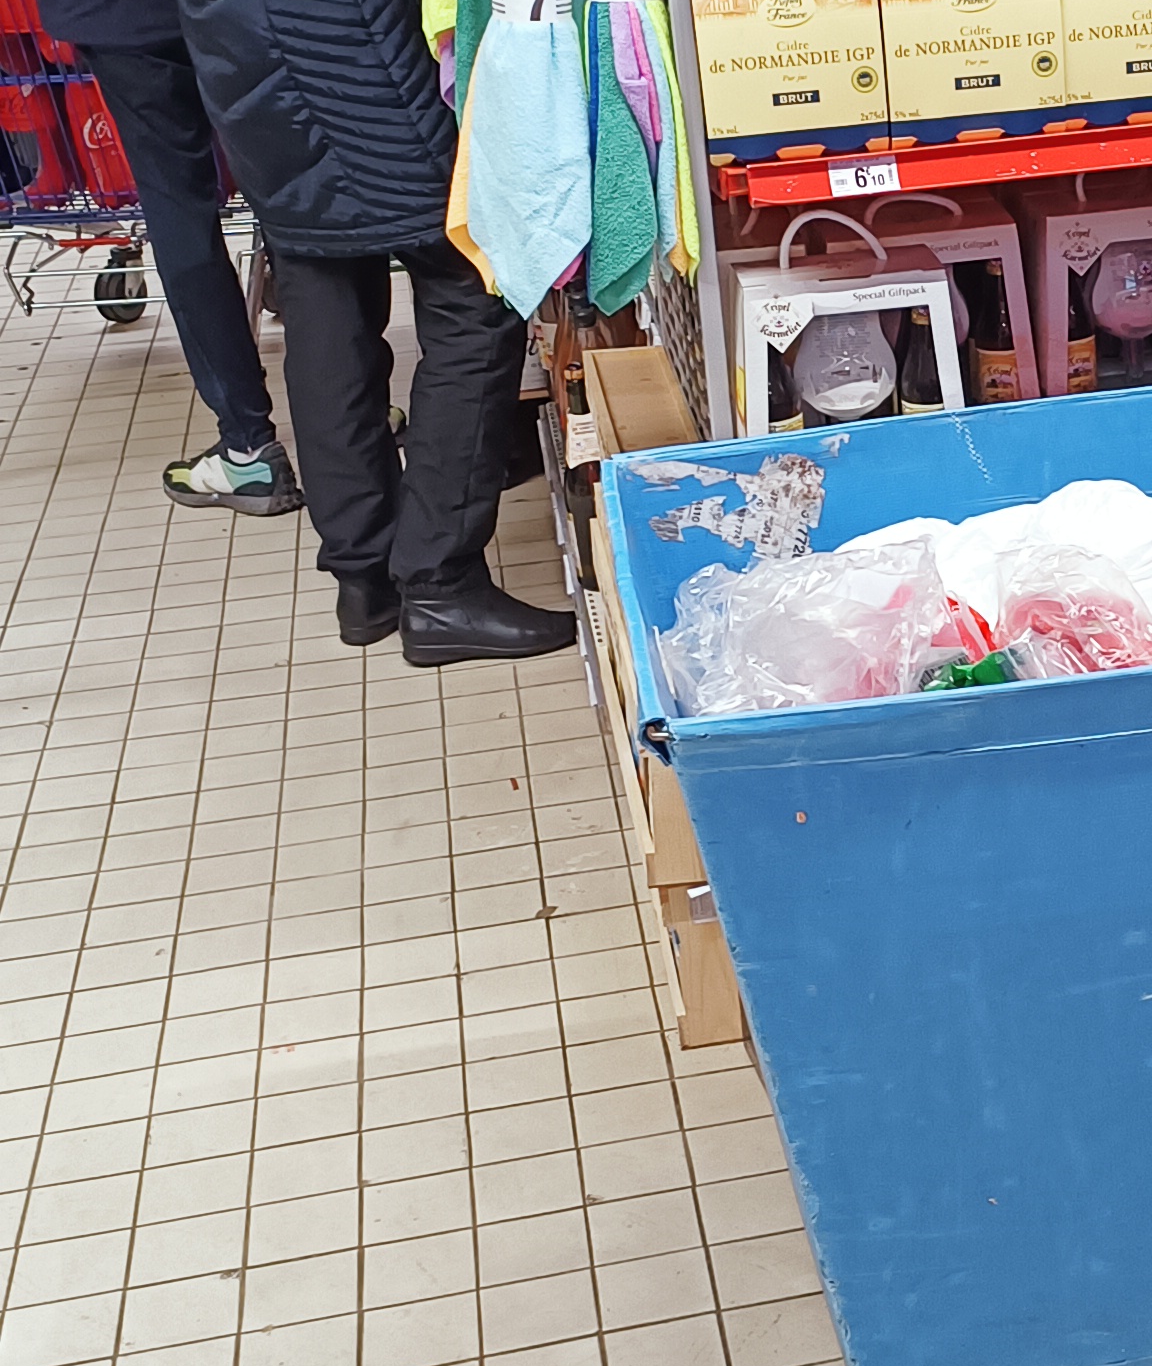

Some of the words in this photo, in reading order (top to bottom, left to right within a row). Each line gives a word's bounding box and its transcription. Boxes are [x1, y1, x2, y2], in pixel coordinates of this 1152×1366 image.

[959, 24, 991, 37] Cidre
[776, 39, 809, 52] Cidre
[894, 44, 911, 59] de
[915, 35, 1022, 57] NORMANDIE
[1027, 31, 1056, 47] IGP
[709, 60, 726, 74] de
[731, 50, 841, 71] NORMANDIE
[846, 46, 876, 62] IGP
[961, 75, 995, 89] BRUT
[780, 91, 814, 105] BRUT
[853, 289, 885, 303] Special
[886, 285, 927, 301] Giftpack
[764, 300, 792, 314] Tripel
[760, 321, 802, 339] Karmeliet
